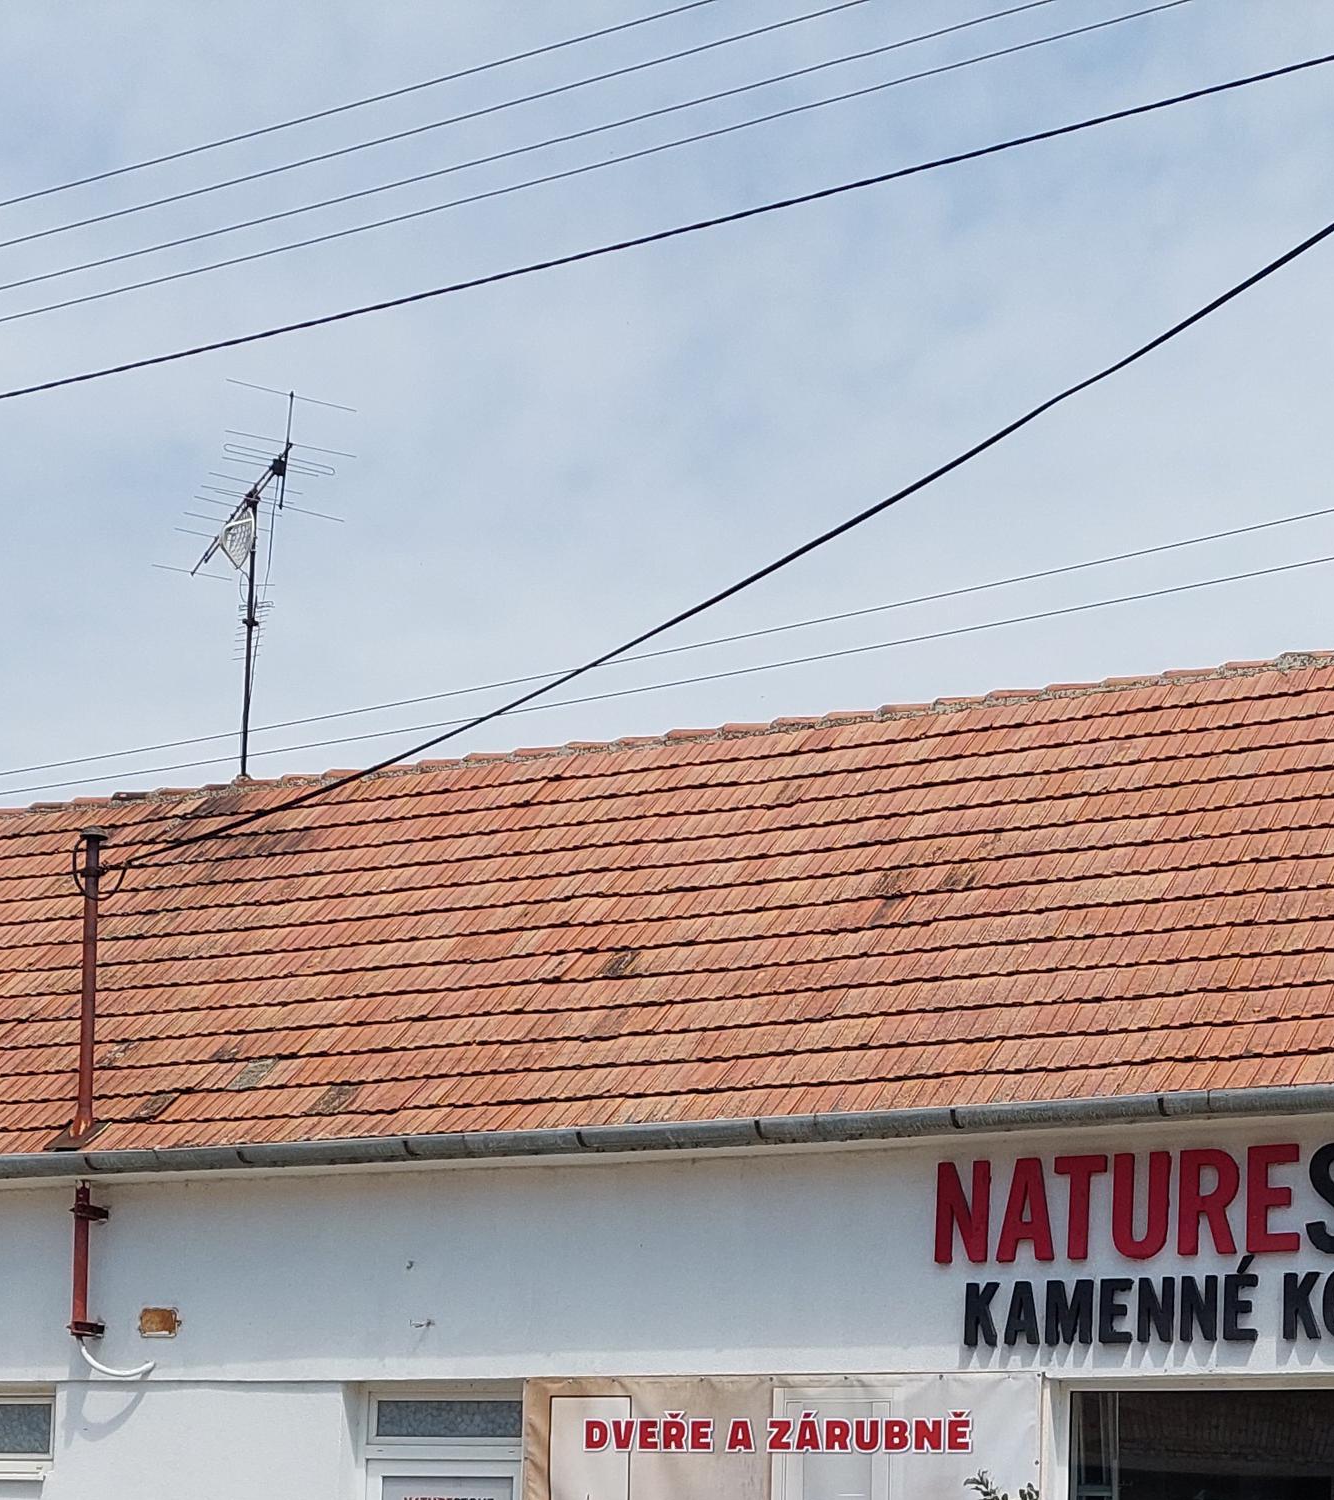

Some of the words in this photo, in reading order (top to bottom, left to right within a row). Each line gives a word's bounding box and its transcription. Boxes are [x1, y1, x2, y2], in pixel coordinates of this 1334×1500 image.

[963, 1255, 1259, 1347] KAMENNÉ
[582, 1410, 714, 1453] DVEŘE
[725, 1417, 755, 1453] A
[766, 1408, 973, 1454] ZÁRUBNĚ
